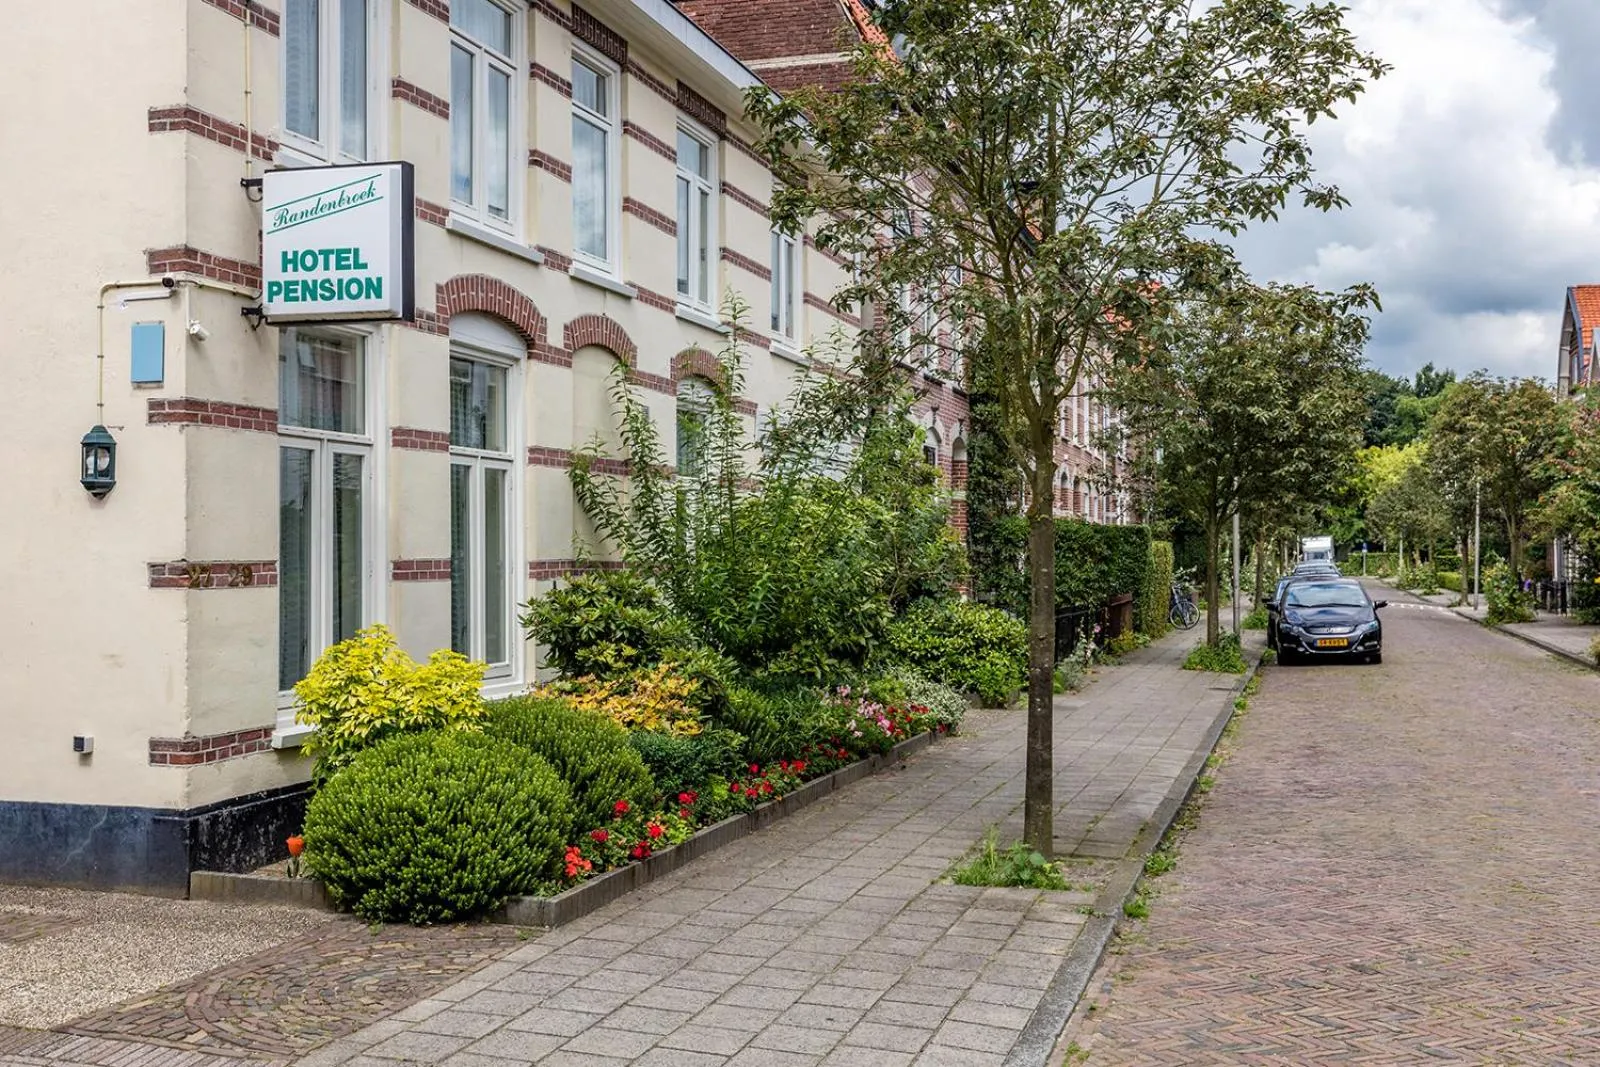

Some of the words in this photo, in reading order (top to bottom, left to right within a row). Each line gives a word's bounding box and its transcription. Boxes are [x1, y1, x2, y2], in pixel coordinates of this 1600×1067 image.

[273, 180, 377, 228] Randenbroek
[281, 248, 368, 273] HOTEL
[267, 276, 383, 303] PENSION
[228, 563, 253, 587] 29
